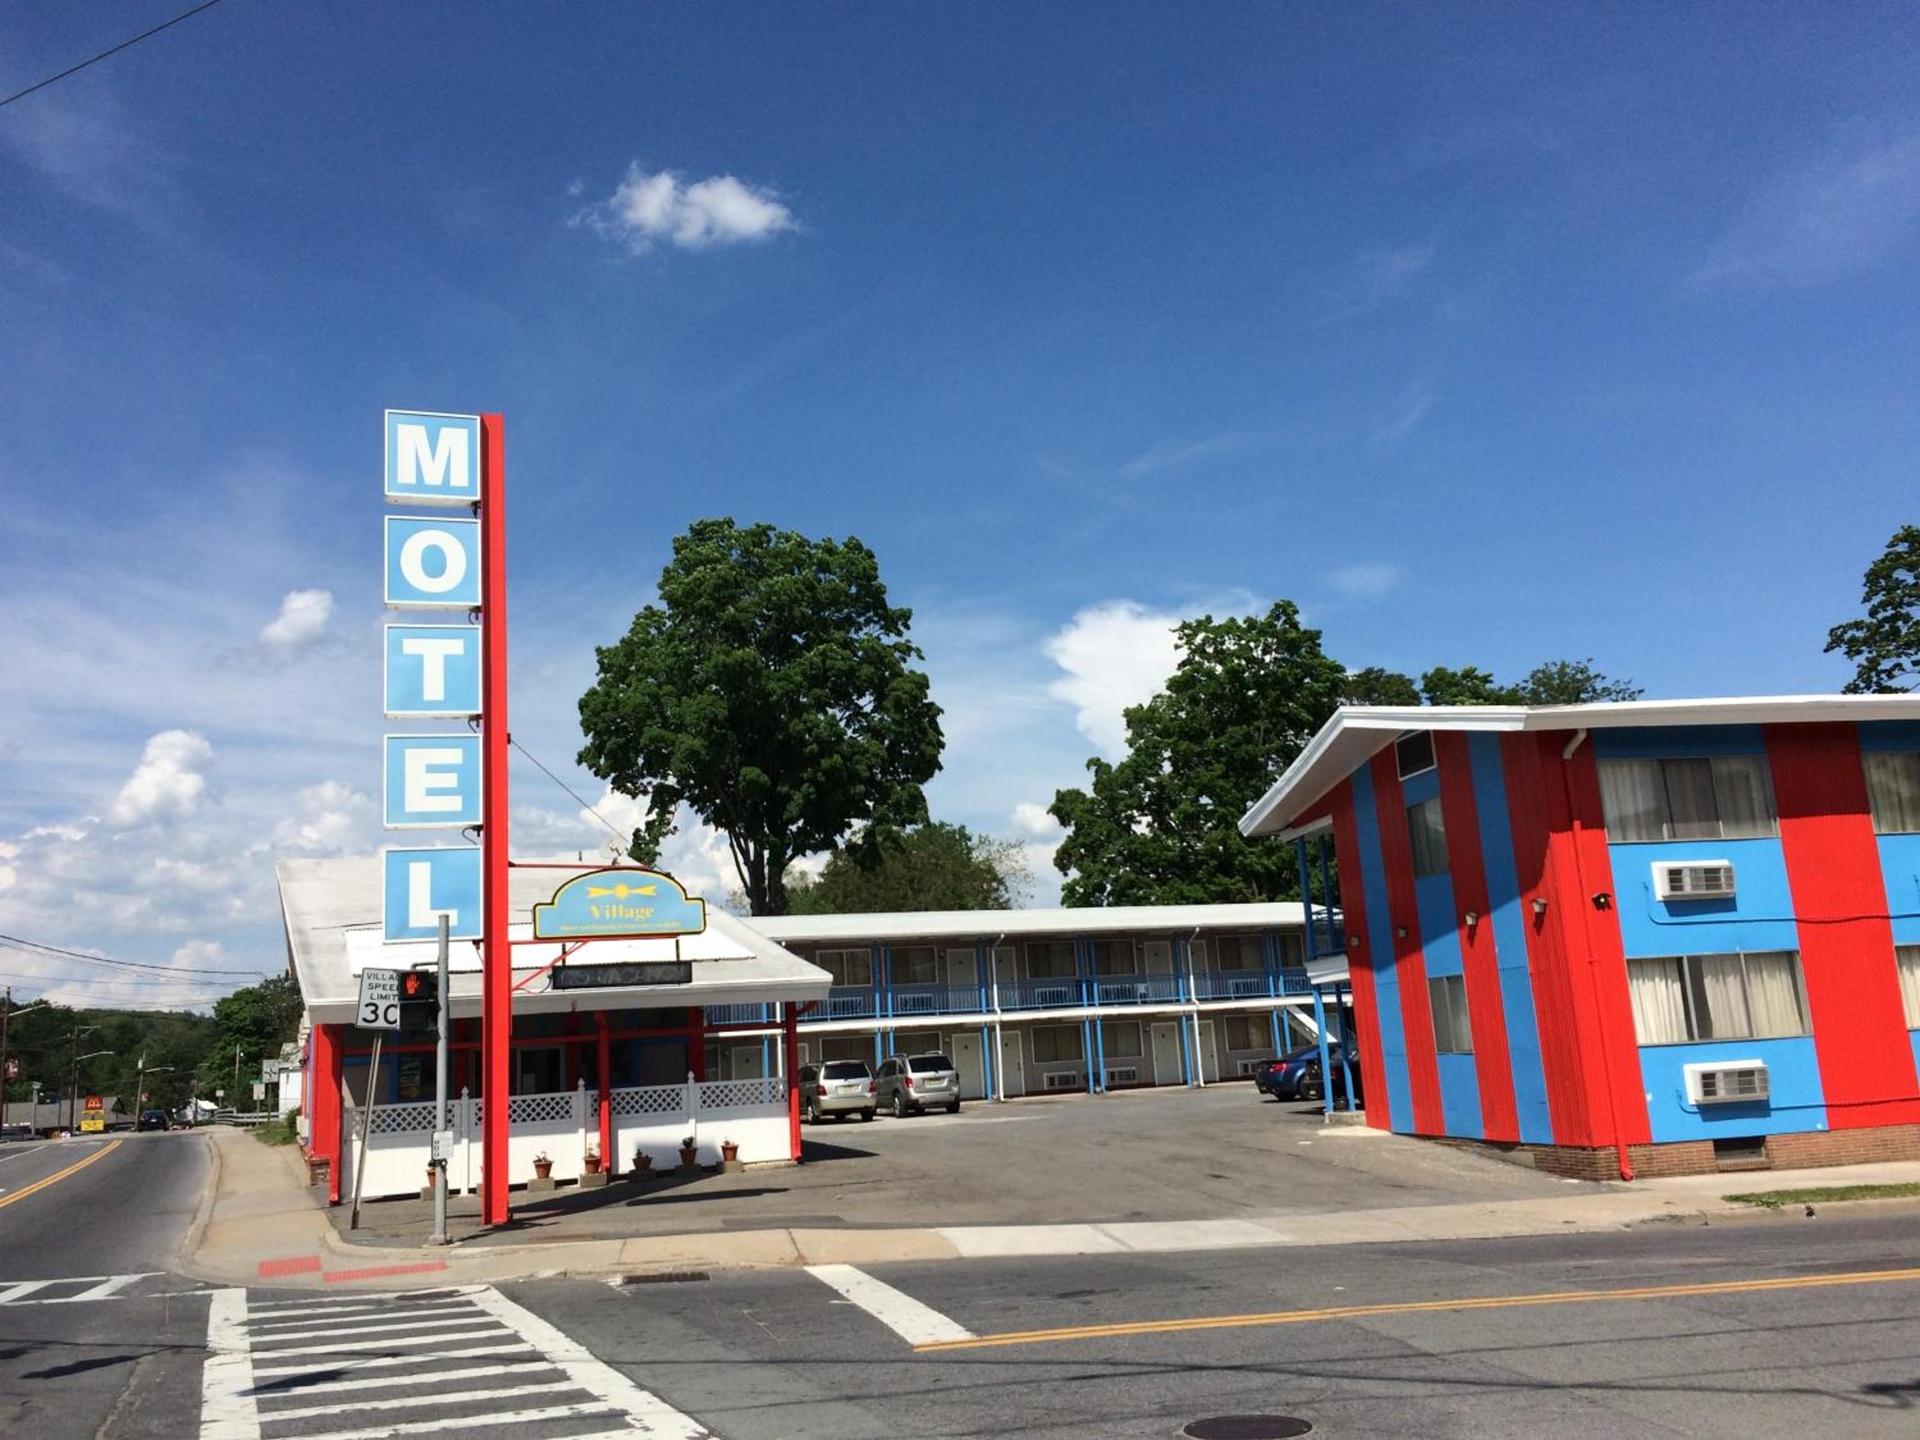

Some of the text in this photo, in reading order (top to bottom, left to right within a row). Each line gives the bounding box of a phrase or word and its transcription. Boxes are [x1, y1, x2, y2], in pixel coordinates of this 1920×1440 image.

[398, 424, 469, 928] MOTEL
[589, 904, 654, 920] Village
[366, 972, 400, 981] VILLA
[368, 982, 400, 992] SPEE
